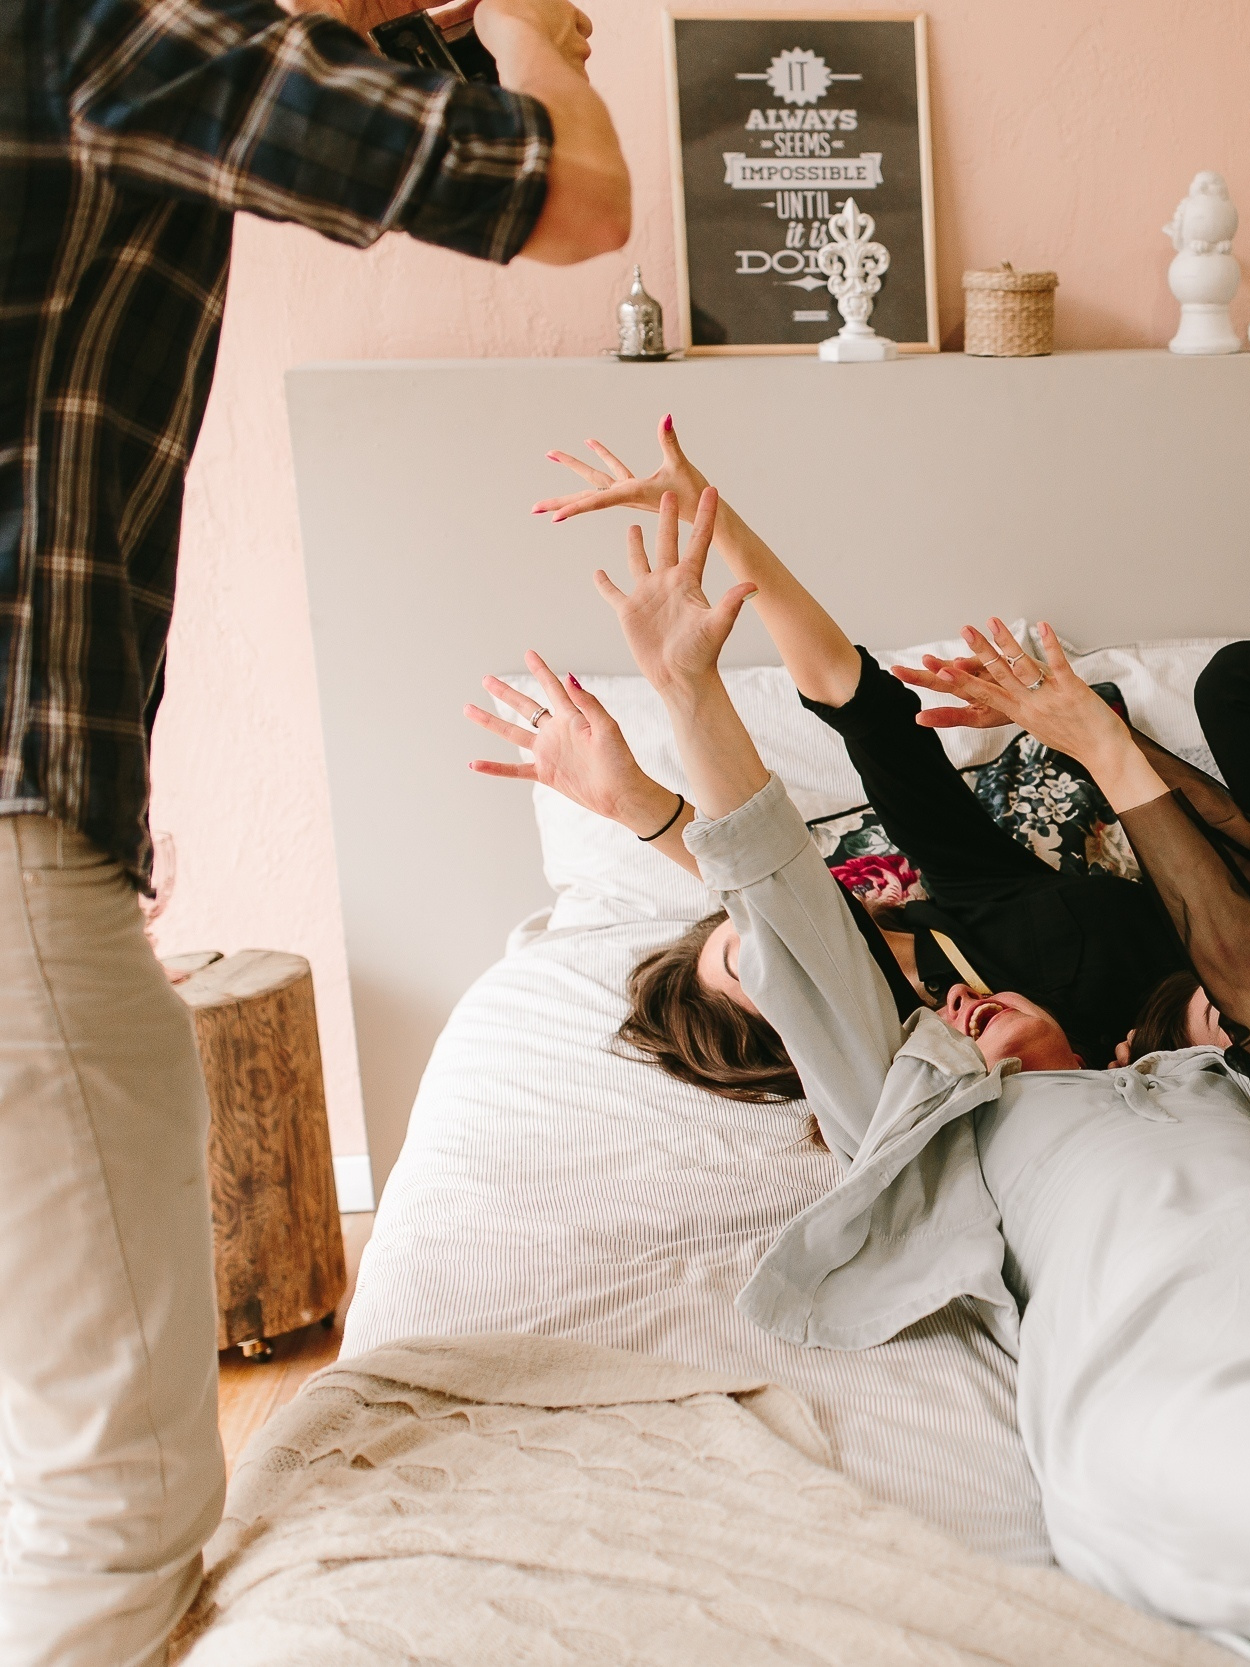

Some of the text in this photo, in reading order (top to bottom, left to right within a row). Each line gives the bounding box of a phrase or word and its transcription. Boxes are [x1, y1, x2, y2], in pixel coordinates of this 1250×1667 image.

[788, 61, 808, 91] IT
[744, 108, 858, 131] ALWAYS
[773, 132, 831, 157] SEEMS
[741, 166, 867, 181] IMPOSSIBLE
[776, 190, 834, 220] UNTIL
[785, 220, 829, 248] it is
